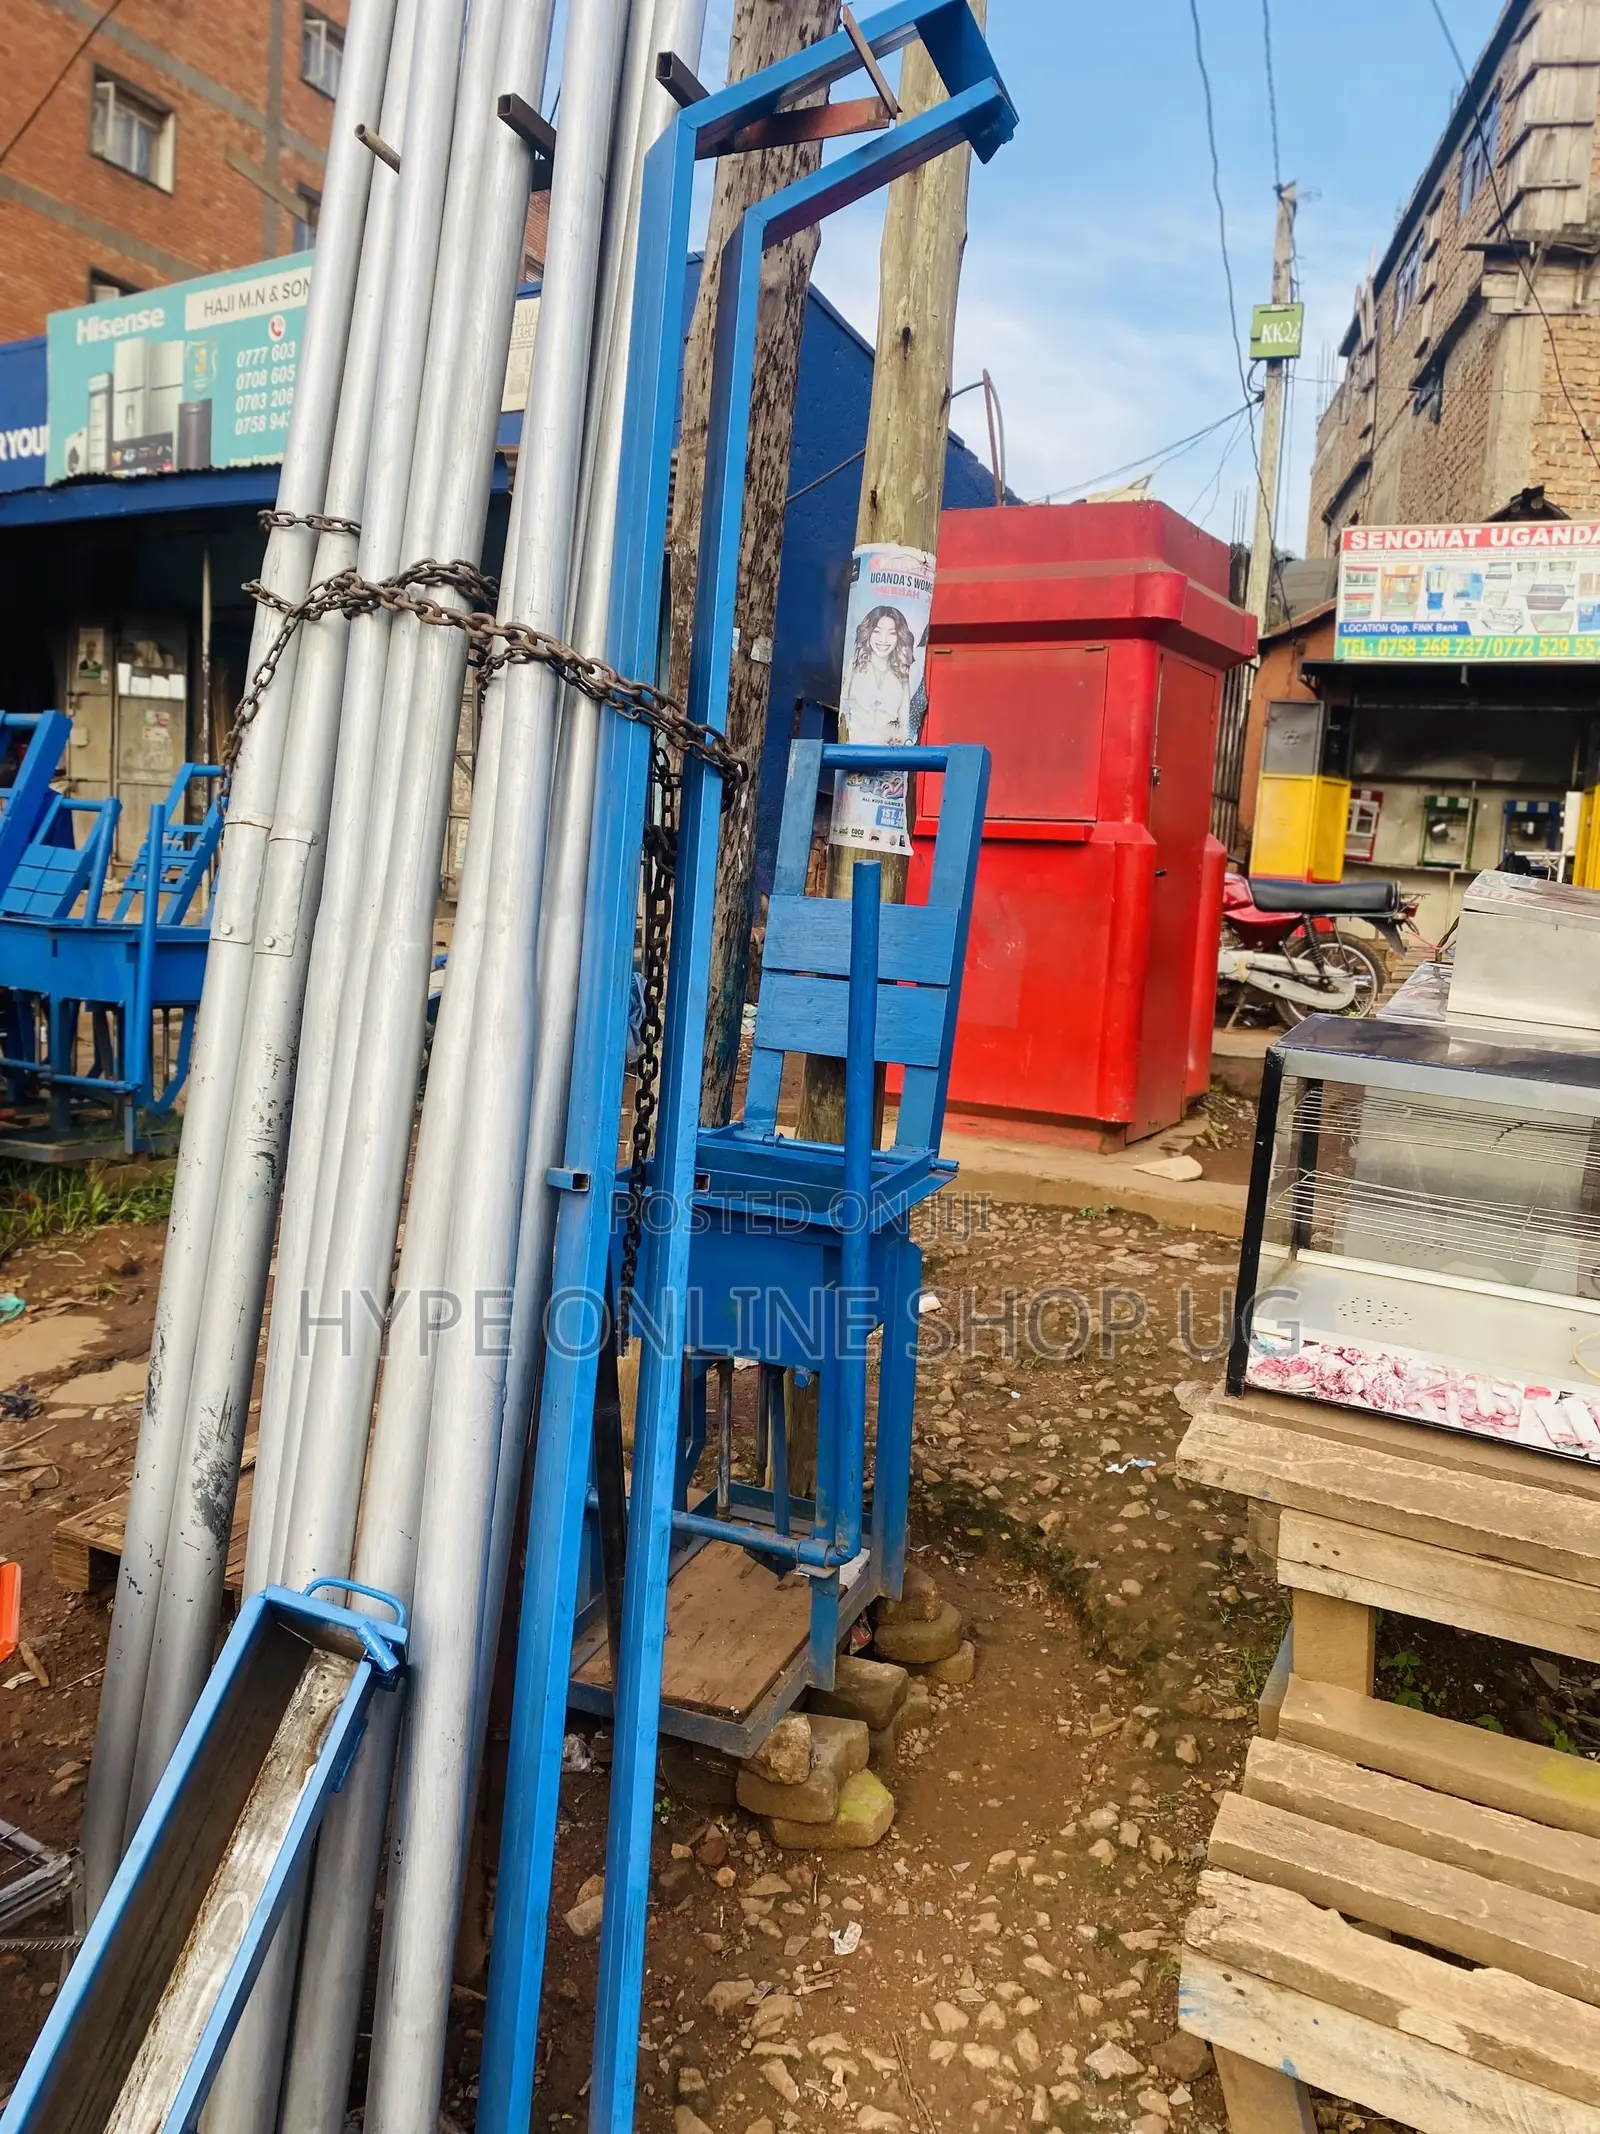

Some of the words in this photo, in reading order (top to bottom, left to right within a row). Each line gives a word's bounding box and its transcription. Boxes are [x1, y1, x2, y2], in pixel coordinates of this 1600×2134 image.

[204, 293, 235, 318] HAJI
[269, 284, 279, 302] &
[76, 308, 165, 345] Hisense
[237, 346, 269, 368] 0777
[271, 340, 296, 362] 603
[236, 369, 268, 391] 0708
[271, 363, 296, 384] 605
[235, 392, 267, 413] 0703
[235, 414, 266, 435] 0758
[1350, 528, 1482, 549] SENOMAT
[870, 572, 912, 587] UGANDA'S
[1343, 623, 1388, 633] LOCATION
[1390, 624, 1410, 634] Opp.
[1413, 623, 1433, 632] FINK
[1435, 623, 1458, 632] Bank
[1342, 638, 1374, 656] TEL:
[1378, 638, 1416, 656] 0758
[1539, 636, 1569, 656] 529
[1574, 636, 1600, 656] 55
